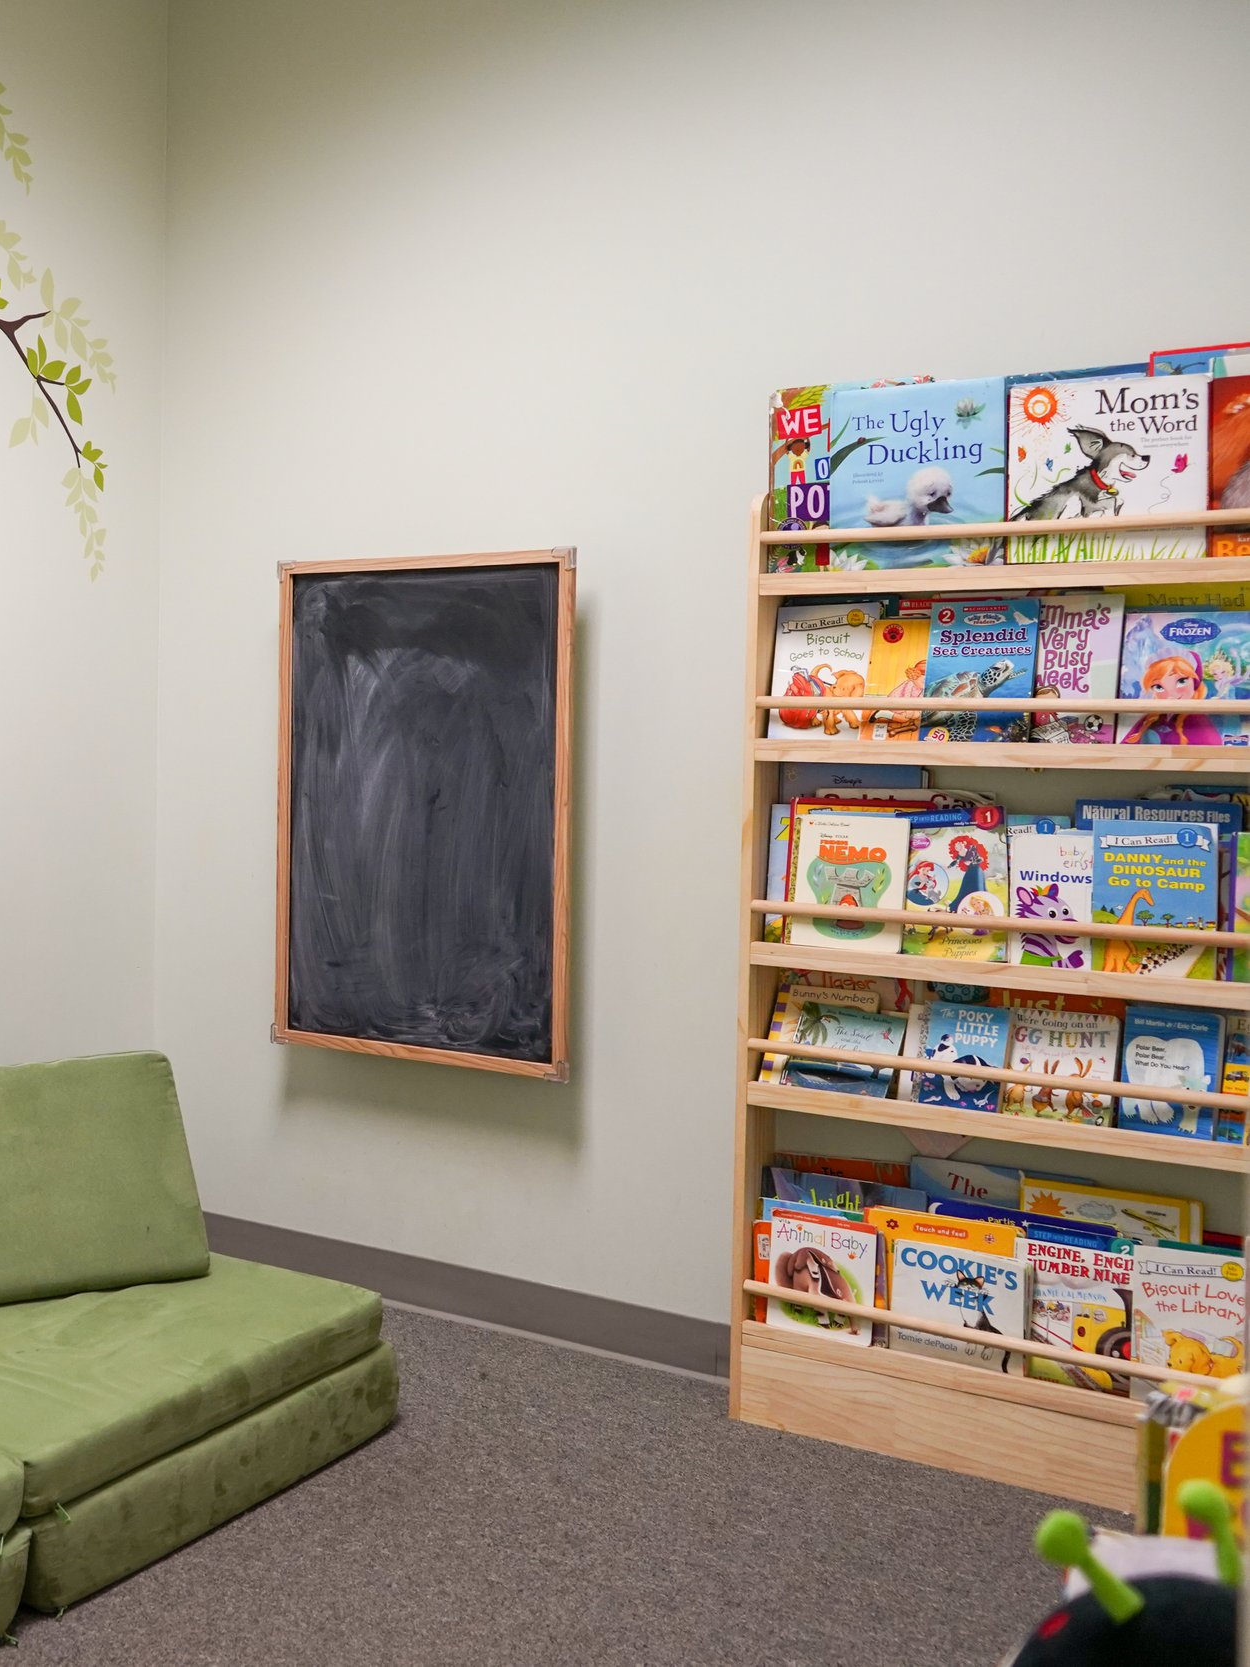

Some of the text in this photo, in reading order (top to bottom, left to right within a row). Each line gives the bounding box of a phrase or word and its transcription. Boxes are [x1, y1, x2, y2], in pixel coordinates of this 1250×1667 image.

[1095, 387, 1200, 415] Mom's
[780, 408, 819, 436] WE
[852, 409, 945, 437] The Ugly
[1110, 415, 1198, 434] the Word
[867, 437, 983, 465] Duckling
[791, 485, 829, 518] PO
[801, 621, 818, 630] Can
[820, 616, 843, 627] Read!
[942, 610, 951, 622] 2
[806, 632, 851, 646] Biscuit
[940, 627, 1027, 646] Splendid
[1041, 627, 1090, 650] Very
[1169, 627, 1211, 637] FROZEN
[790, 647, 864, 662] Goes to School
[932, 646, 1031, 656] Sea Creatures
[1044, 649, 1093, 674] Busy
[932, 731, 945, 742] 50
[831, 775, 862, 786] Disney's
[931, 813, 962, 822] READING
[985, 811, 991, 822] 1
[1134, 806, 1204, 822] Resources
[1206, 812, 1231, 823] Files
[1006, 824, 1048, 835] Read! 1
[1122, 837, 1142, 846] Can
[1145, 836, 1173, 844] Read!
[1184, 833, 1190, 842] 1
[819, 845, 887, 862] NEMO
[1060, 846, 1086, 860] baby
[1104, 852, 1207, 867] DANNY and the
[1020, 870, 1093, 884] Windows
[1113, 865, 1201, 878] DINOSAUR
[1108, 876, 1205, 892] Go to Camp
[941, 936, 982, 945] Princesses
[944, 948, 977, 959] Puppies
[793, 989, 875, 1004] Bunny's Numbers
[941, 1008, 994, 1023] The POKY
[1017, 1014, 1039, 1025] We're
[1042, 1018, 1068, 1030] Going
[1071, 1021, 1084, 1029] on
[956, 1021, 999, 1036] LITTLE
[1146, 1019, 1166, 1027] Martin
[1177, 1022, 1190, 1030] Eric
[954, 1032, 999, 1048] PUPPY
[1013, 1024, 1110, 1048] GG HUNT
[948, 1172, 988, 1199] The
[777, 1223, 826, 1247] Animal
[831, 1232, 868, 1259] Baby
[1034, 1230, 1052, 1240] STEP
[1064, 1236, 1098, 1249] READING
[1027, 1243, 1085, 1263] ENGINE,
[1120, 1245, 1130, 1256] 2
[901, 1247, 1018, 1291] COOKIE'S
[1093, 1268, 1130, 1285] NINE
[1162, 1266, 1184, 1274] Can
[1186, 1267, 1217, 1275] Read!
[1142, 1281, 1200, 1298] Biscuit
[920, 1280, 995, 1316] WEEK
[1155, 1298, 1245, 1325] the Library
[897, 1331, 958, 1352] Tomie dePaola
